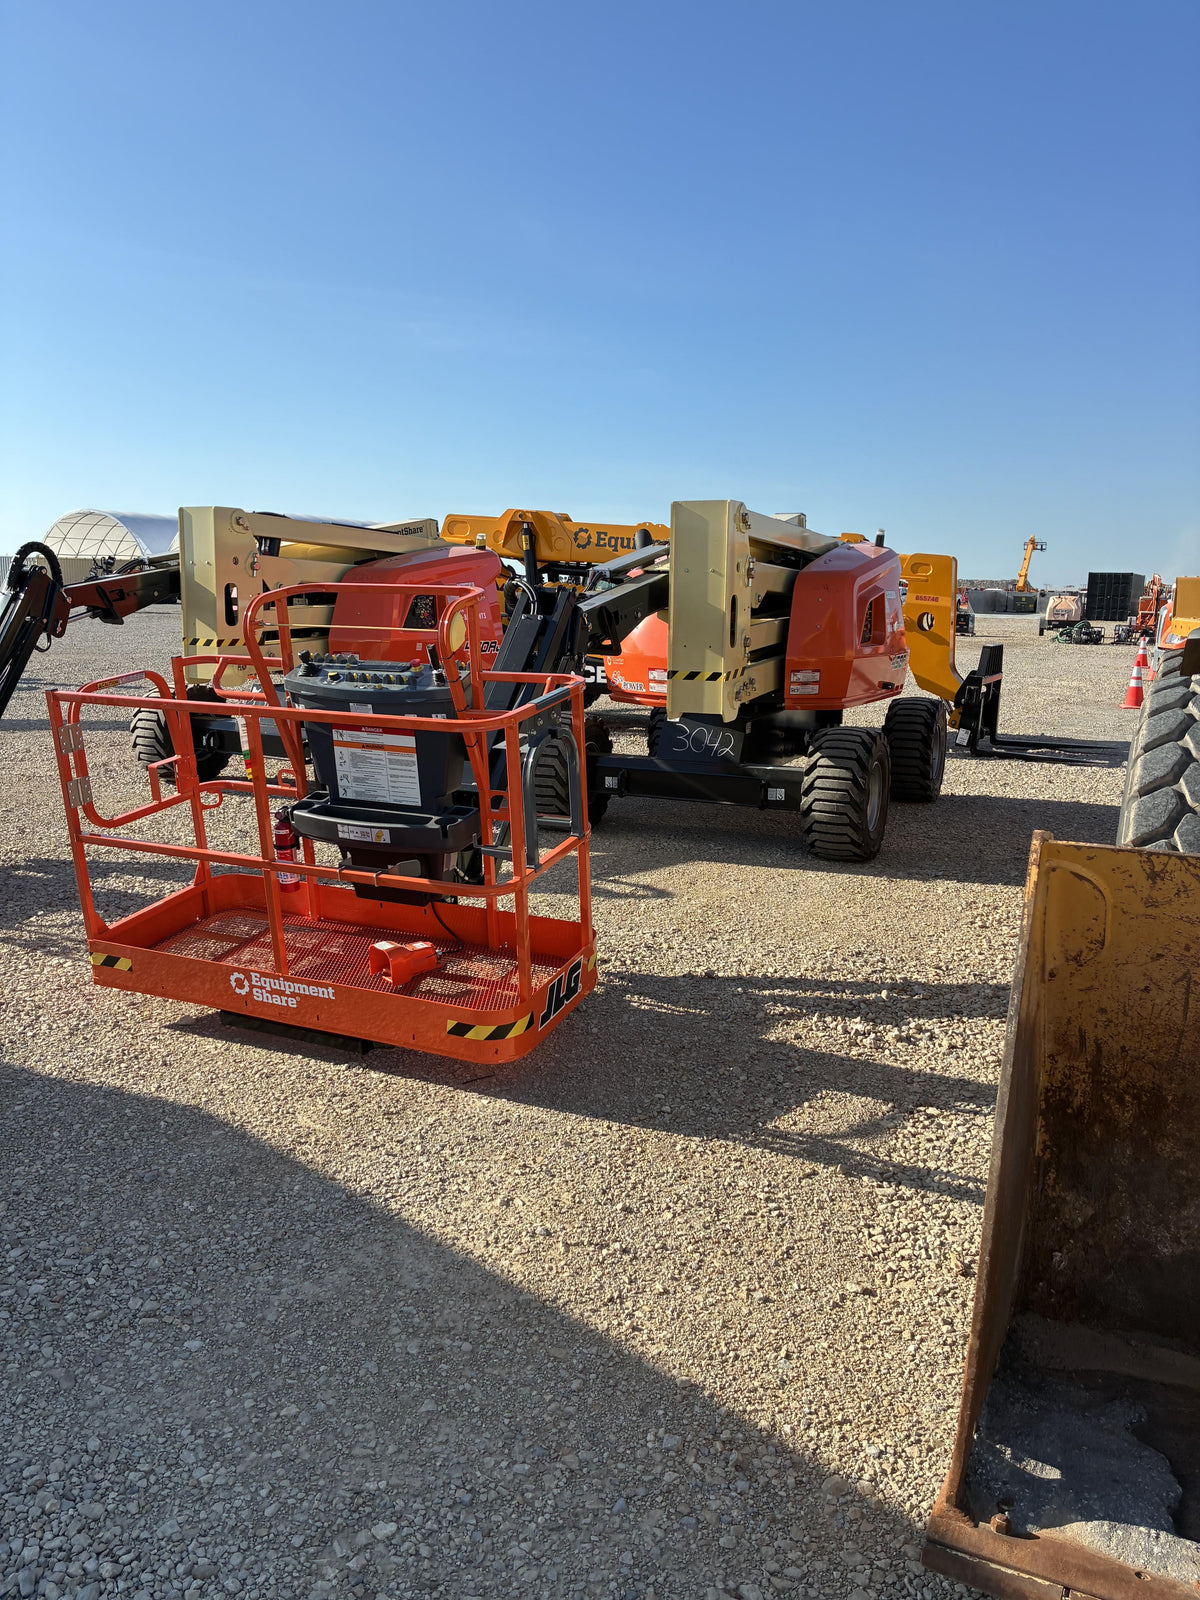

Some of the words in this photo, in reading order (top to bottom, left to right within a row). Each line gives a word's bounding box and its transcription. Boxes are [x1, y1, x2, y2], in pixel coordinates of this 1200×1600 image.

[672, 723, 735, 757] 3042
[250, 972, 336, 1000] Equipment
[252, 988, 297, 1008] Share
[538, 954, 583, 1032] JLG
